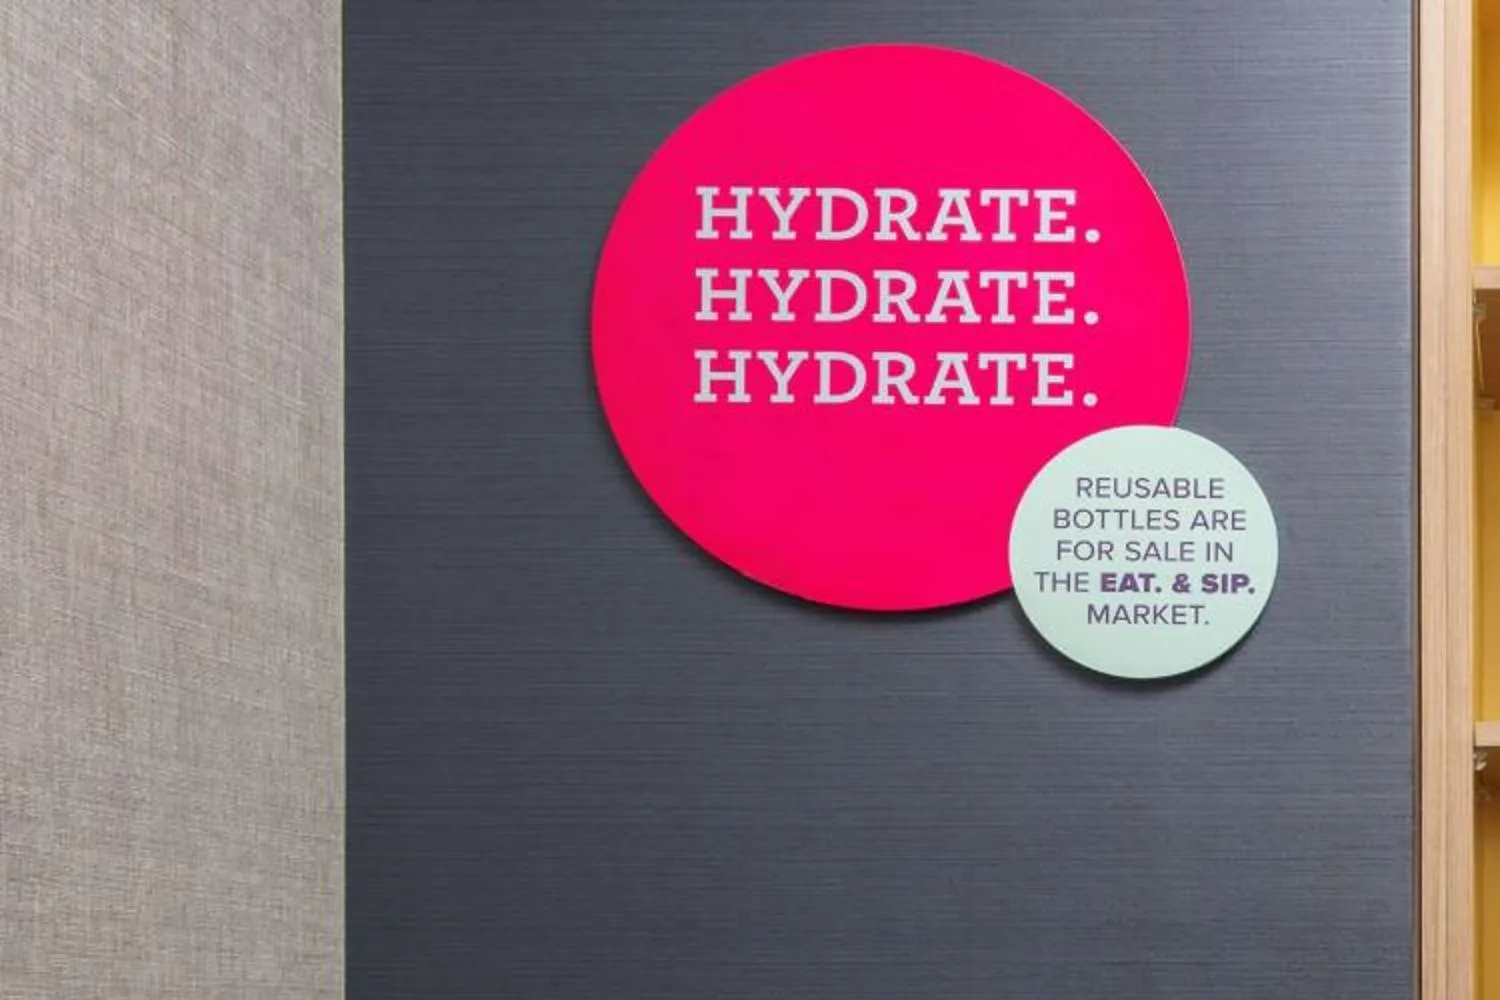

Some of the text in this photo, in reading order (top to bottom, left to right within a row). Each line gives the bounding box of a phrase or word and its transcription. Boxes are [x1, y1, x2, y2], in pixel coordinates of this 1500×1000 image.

[695, 186, 1101, 243] HYDRATE.
[694, 268, 1100, 325] HYDRATE.
[693, 349, 1098, 407] HYDRATE.
[1076, 477, 1226, 499] REUSABLE
[1053, 508, 1247, 531] BOTTLES ARE
[1057, 540, 1234, 562] FOR SALE IN
[1034, 571, 1255, 595] THE EAT. & SIP.
[1087, 603, 1211, 626] MARKET.
